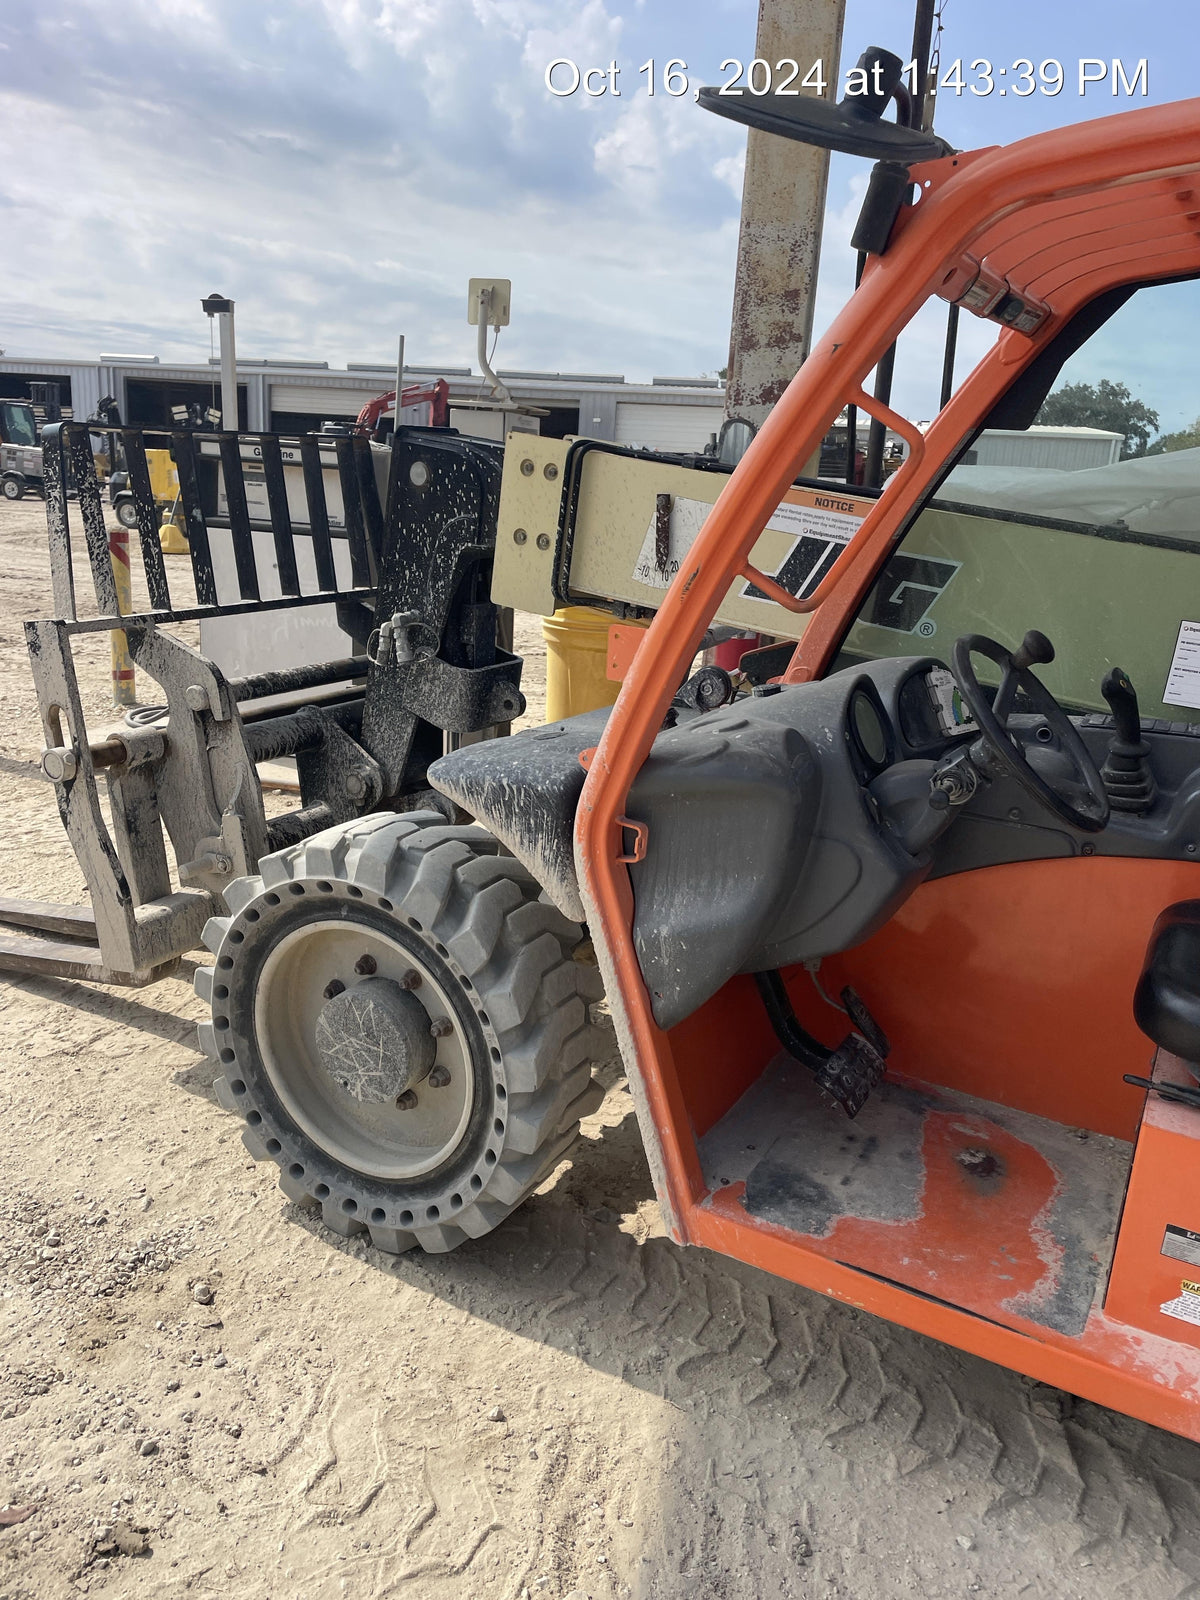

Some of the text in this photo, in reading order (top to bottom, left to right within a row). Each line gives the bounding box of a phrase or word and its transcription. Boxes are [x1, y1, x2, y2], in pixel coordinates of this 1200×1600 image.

[814, 497, 855, 512] NOTICE
[637, 564, 650, 578] -10
[670, 560, 679, 573] 20
